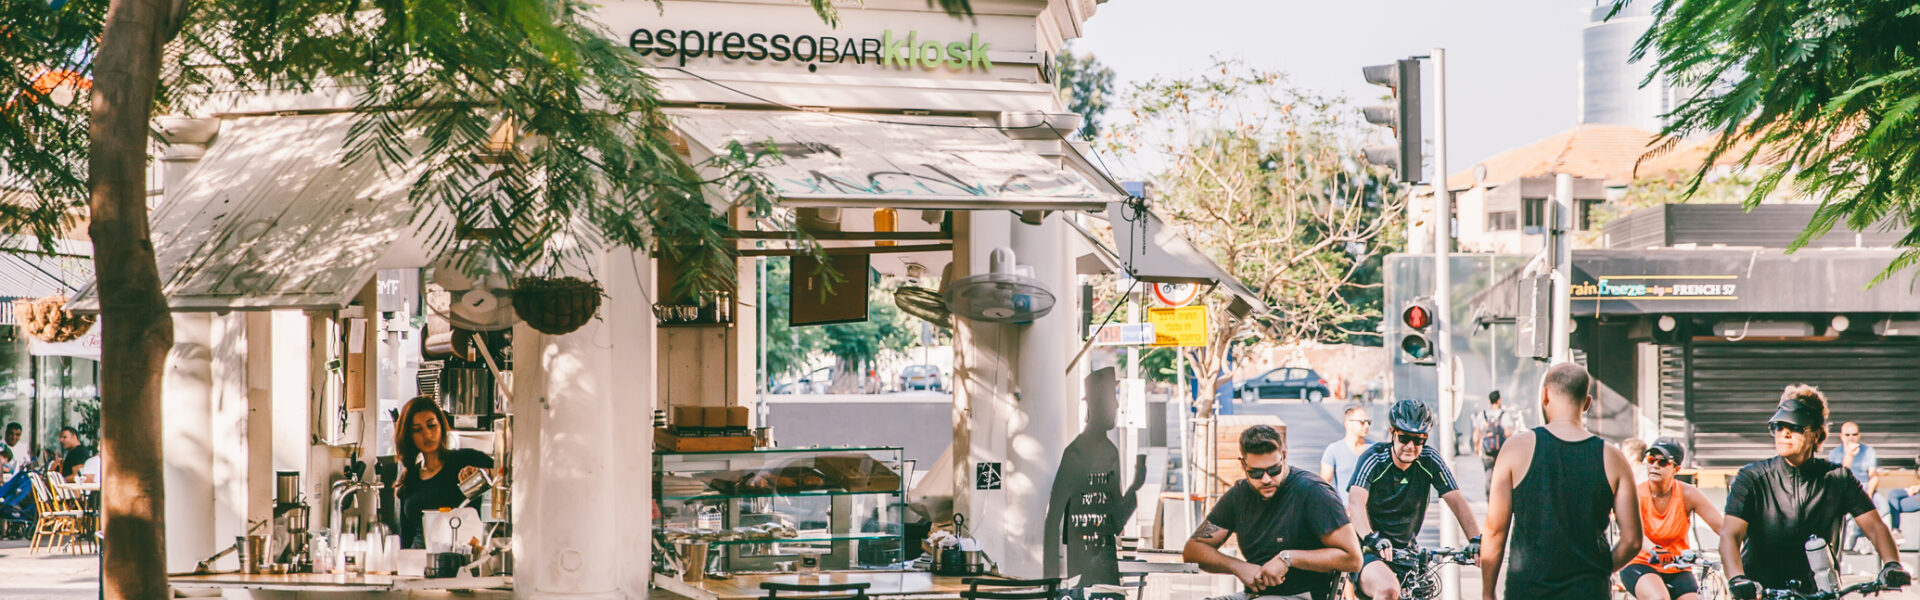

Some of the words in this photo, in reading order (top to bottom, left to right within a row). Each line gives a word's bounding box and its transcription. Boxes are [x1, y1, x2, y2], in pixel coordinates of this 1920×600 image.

[883, 29, 994, 69] kiosk
[1570, 281, 1598, 296] rain
[1672, 284, 1721, 296] FRENCH
[1722, 284, 1736, 296] 57
